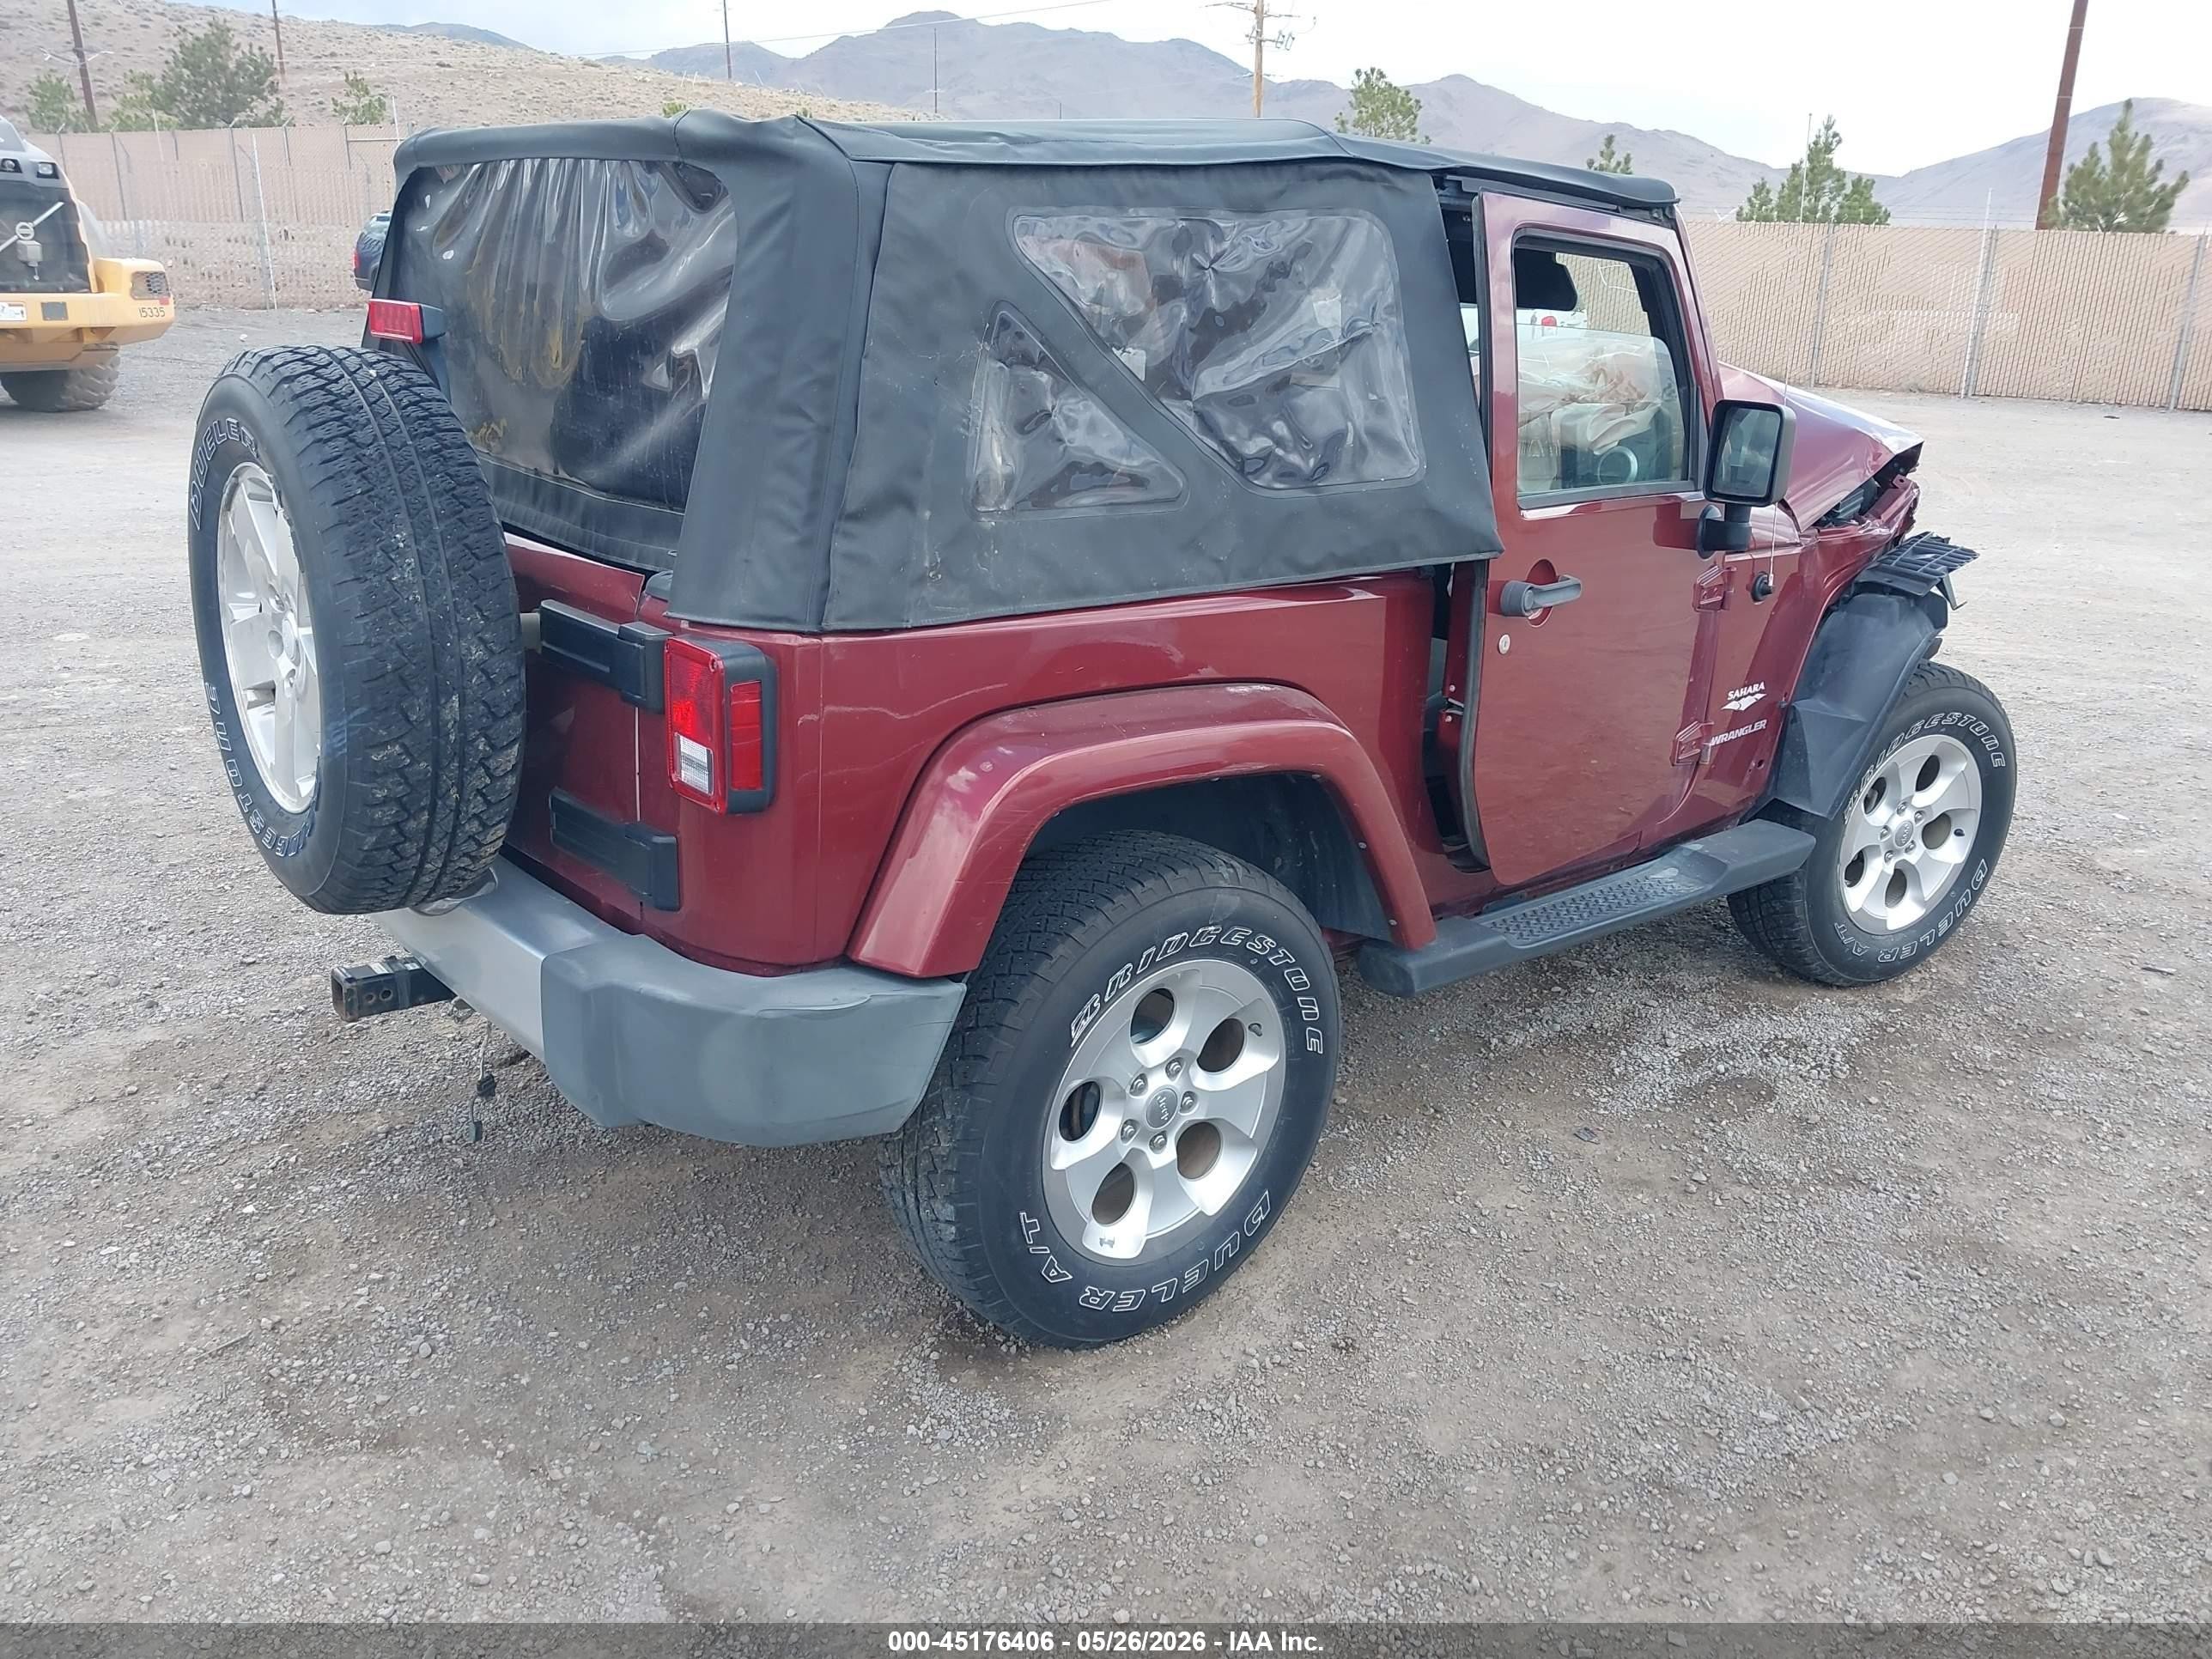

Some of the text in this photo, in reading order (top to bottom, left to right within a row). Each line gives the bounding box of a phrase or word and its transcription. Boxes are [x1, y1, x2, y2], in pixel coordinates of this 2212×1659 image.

[139, 307, 166, 318] 15335
[1727, 681, 1765, 701] SAHARA
[1710, 719, 1767, 746] WRANGLER
[1834, 859, 1989, 963] DUELER A/T
[1071, 926, 1323, 1054] BRIDGESTONE
[1019, 1189, 1271, 1312] DUELER A/T
